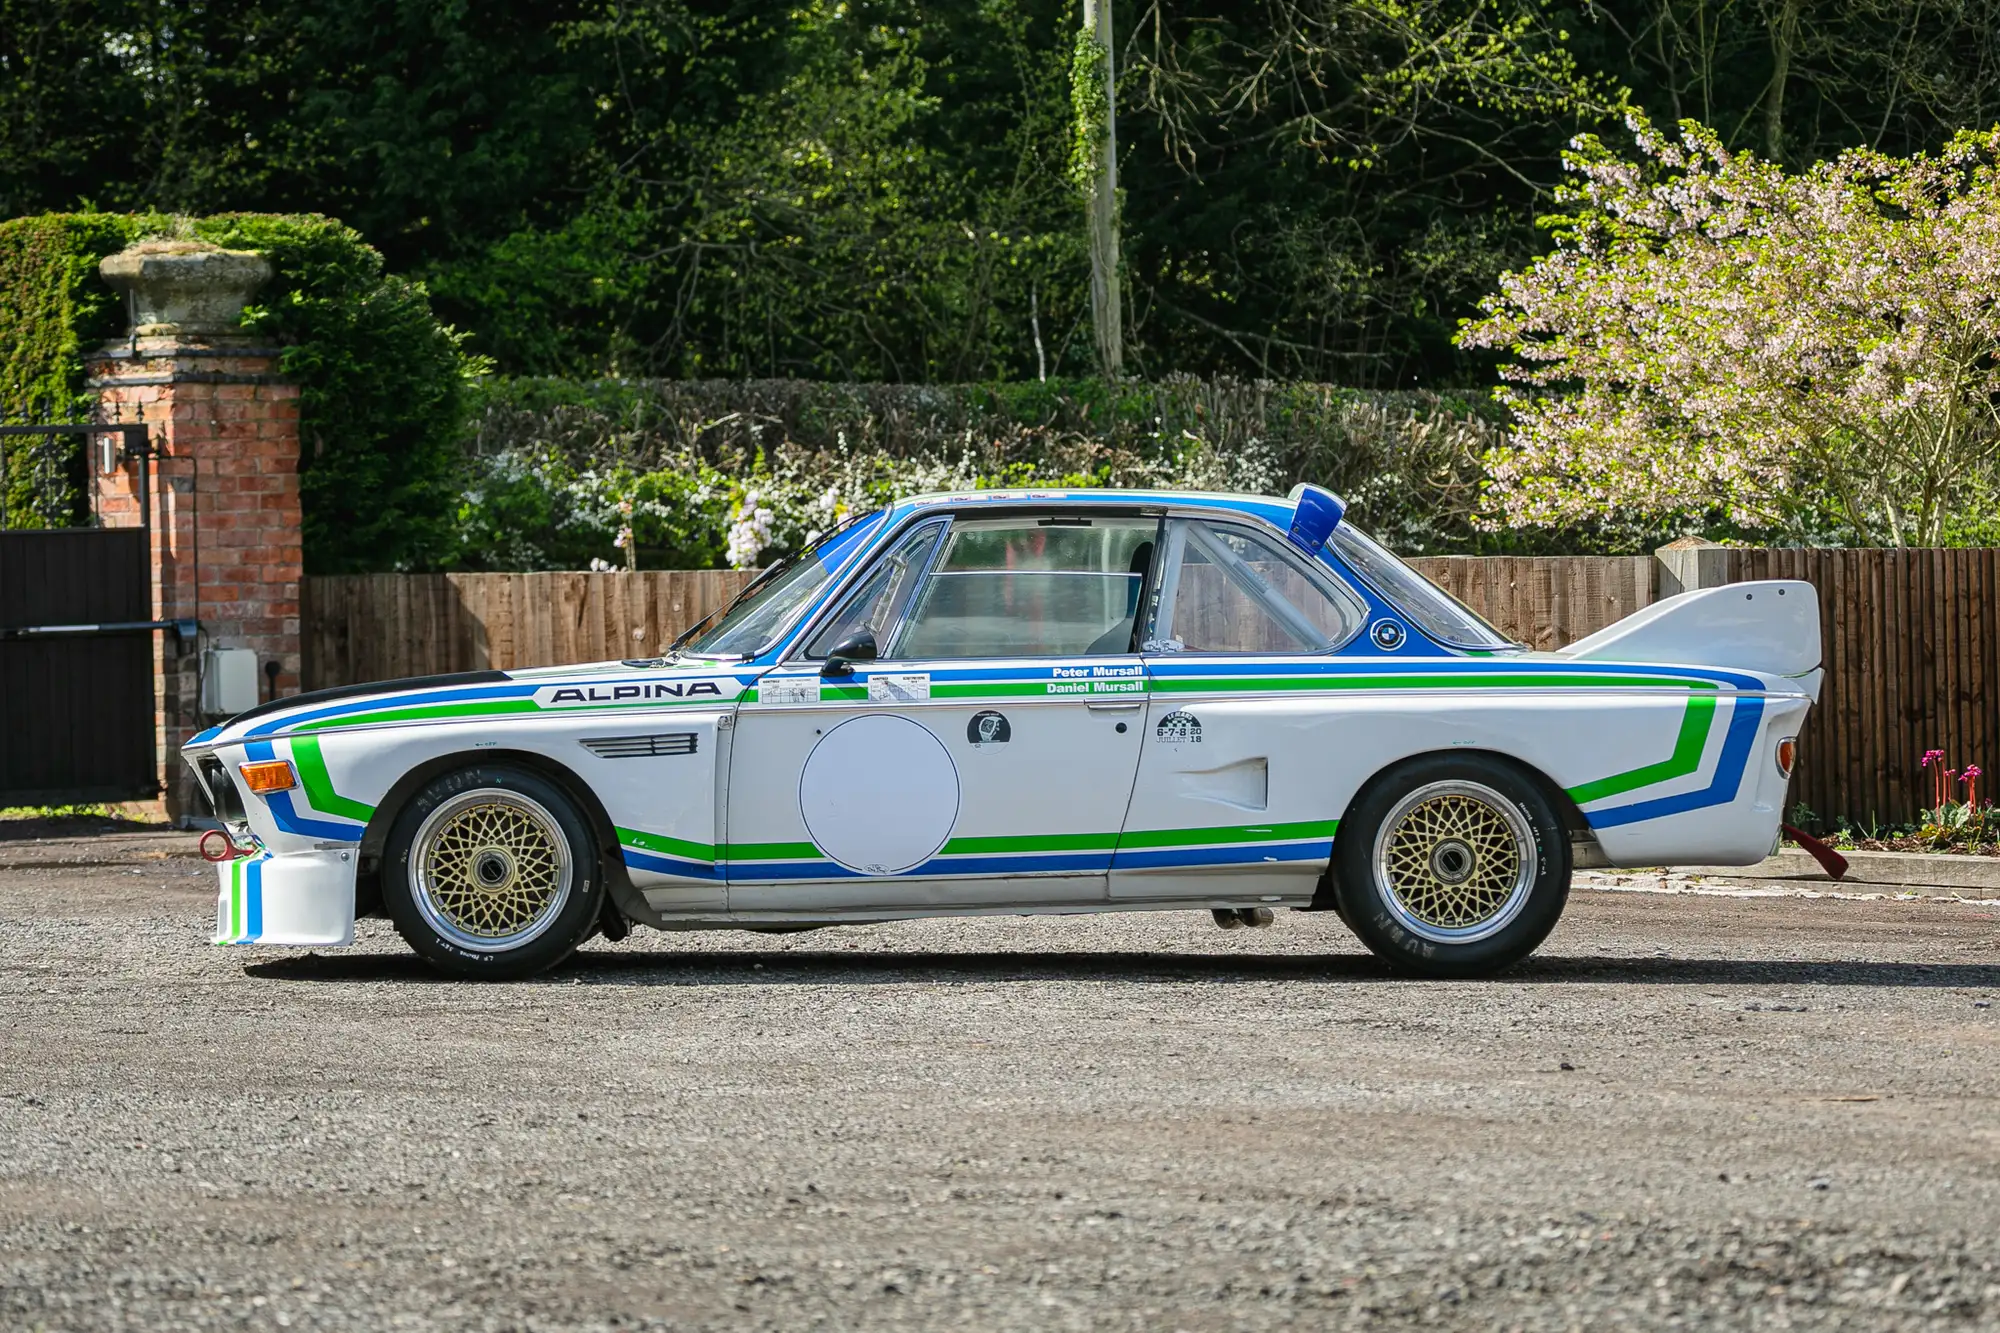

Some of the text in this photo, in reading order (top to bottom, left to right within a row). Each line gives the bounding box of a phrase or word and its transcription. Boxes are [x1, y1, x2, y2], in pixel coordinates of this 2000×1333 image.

[1053, 666, 1143, 678] Peter Mursall
[550, 683, 721, 703] ALPINA
[1047, 681, 1143, 694] Daniel Mursall
[1157, 728, 1186, 737] 6-7-8
